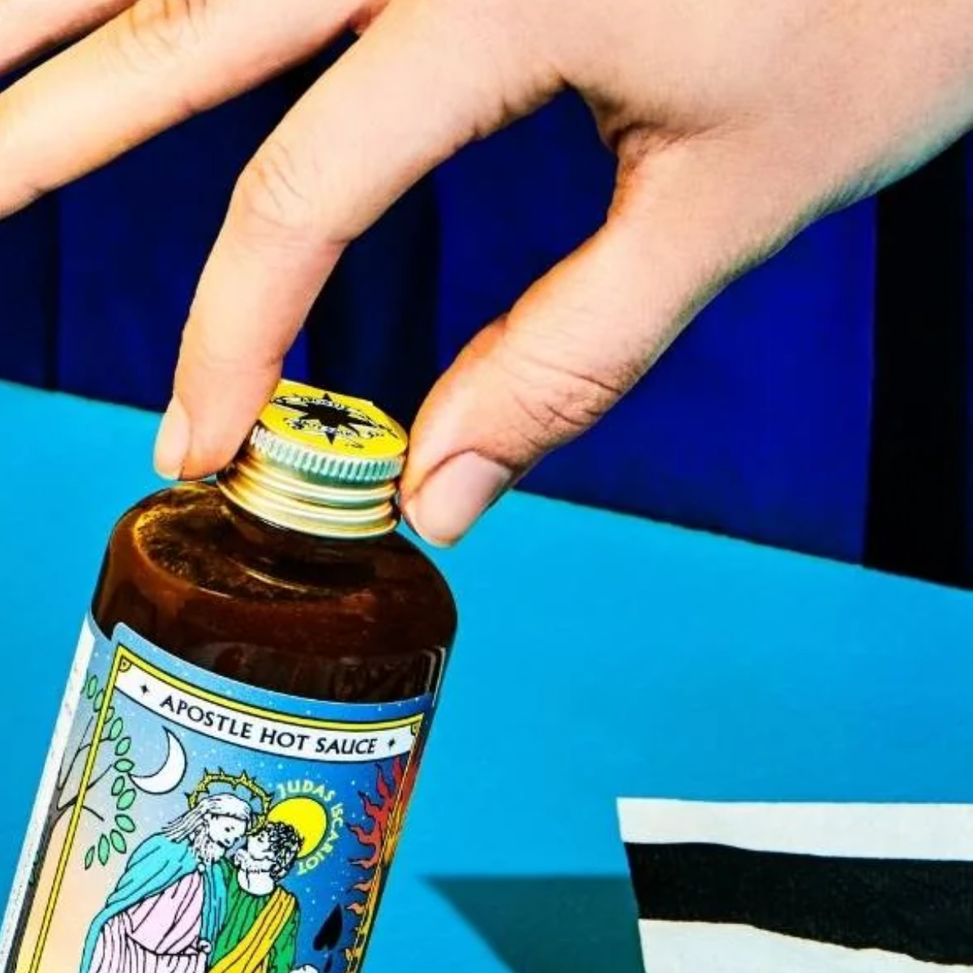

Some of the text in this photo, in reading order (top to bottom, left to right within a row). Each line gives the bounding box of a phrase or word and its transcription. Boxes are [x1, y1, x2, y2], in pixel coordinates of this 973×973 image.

[159, 695, 378, 755] APOSTLE HOT SAUCE
[276, 779, 336, 802] JUDAS
